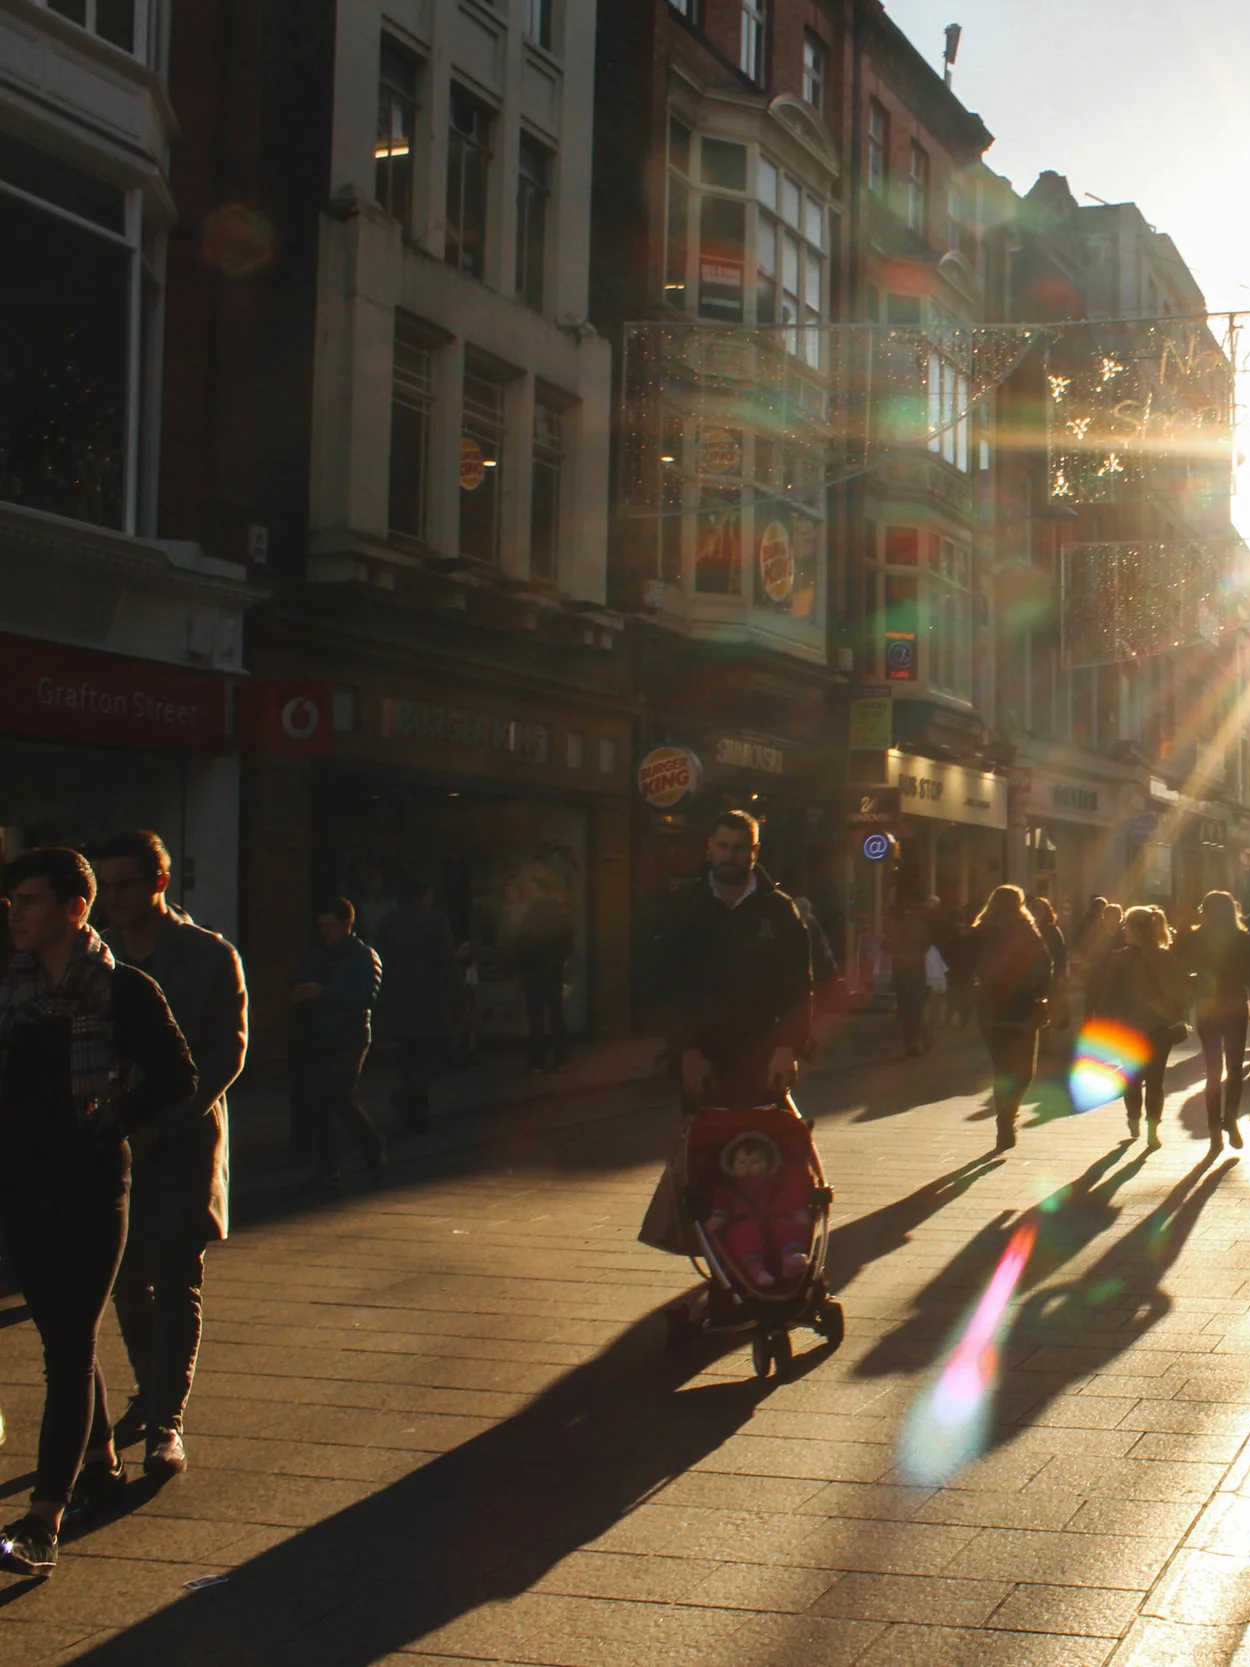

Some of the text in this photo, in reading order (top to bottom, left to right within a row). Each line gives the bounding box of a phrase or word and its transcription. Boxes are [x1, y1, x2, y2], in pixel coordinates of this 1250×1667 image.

[37, 677, 198, 727] Grafton Street
[640, 757, 688, 781] BURGER
[642, 769, 689, 798] KING
